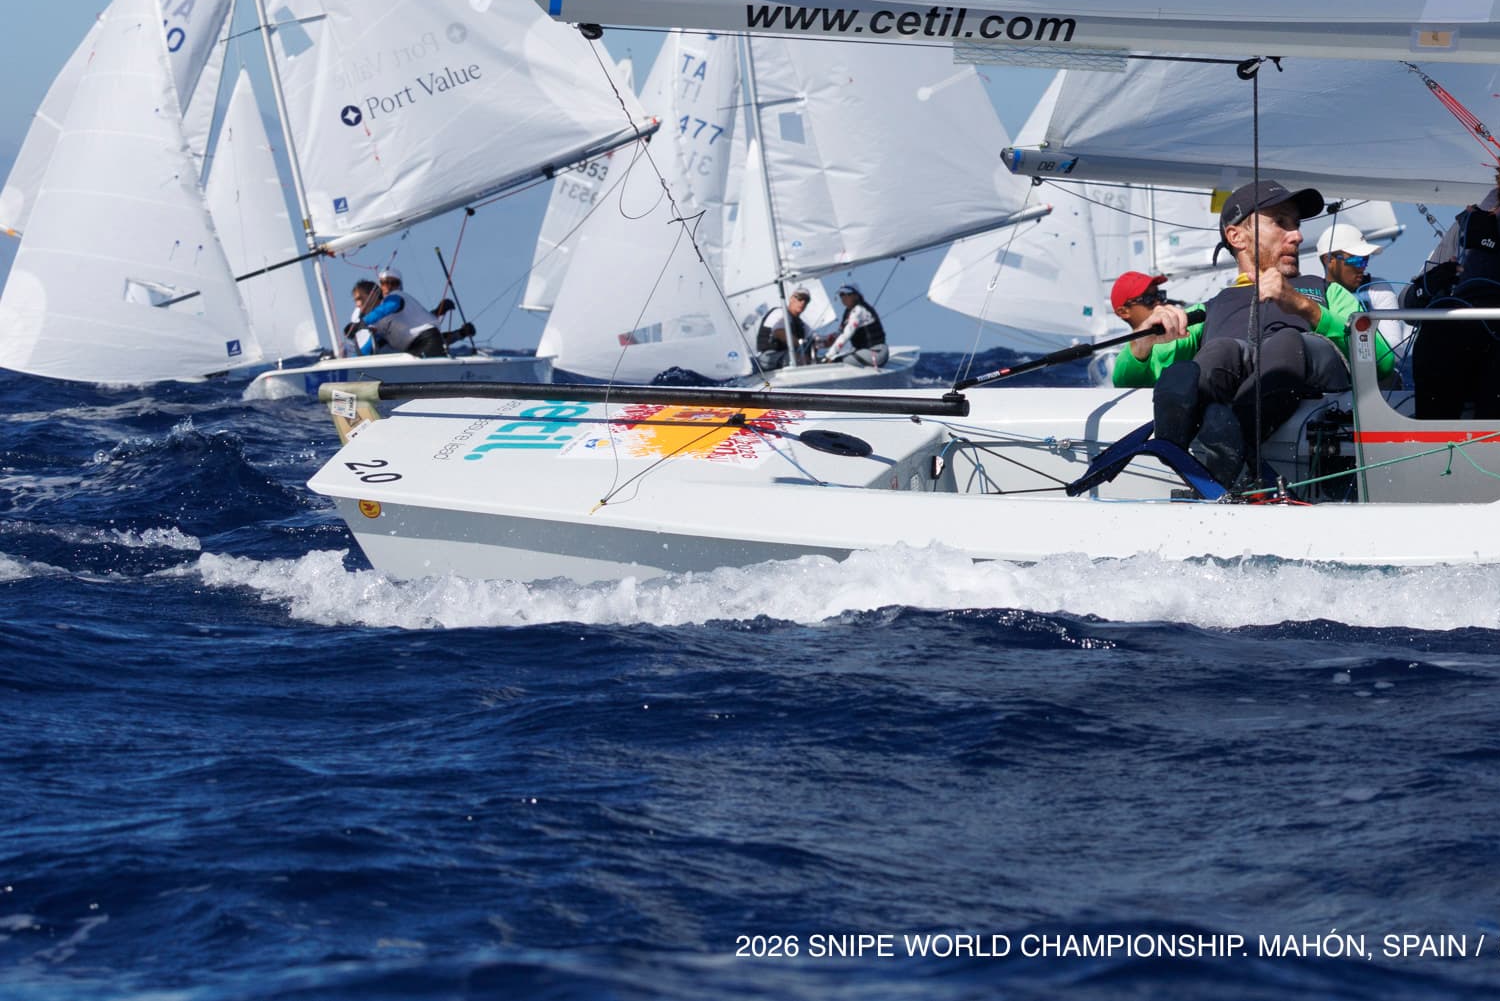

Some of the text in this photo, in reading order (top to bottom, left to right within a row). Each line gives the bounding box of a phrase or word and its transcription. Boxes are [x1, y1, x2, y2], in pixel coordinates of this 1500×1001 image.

[746, 4, 1077, 42] www.cetil.com
[366, 63, 483, 120] Port Value
[343, 459, 403, 484] 2.0
